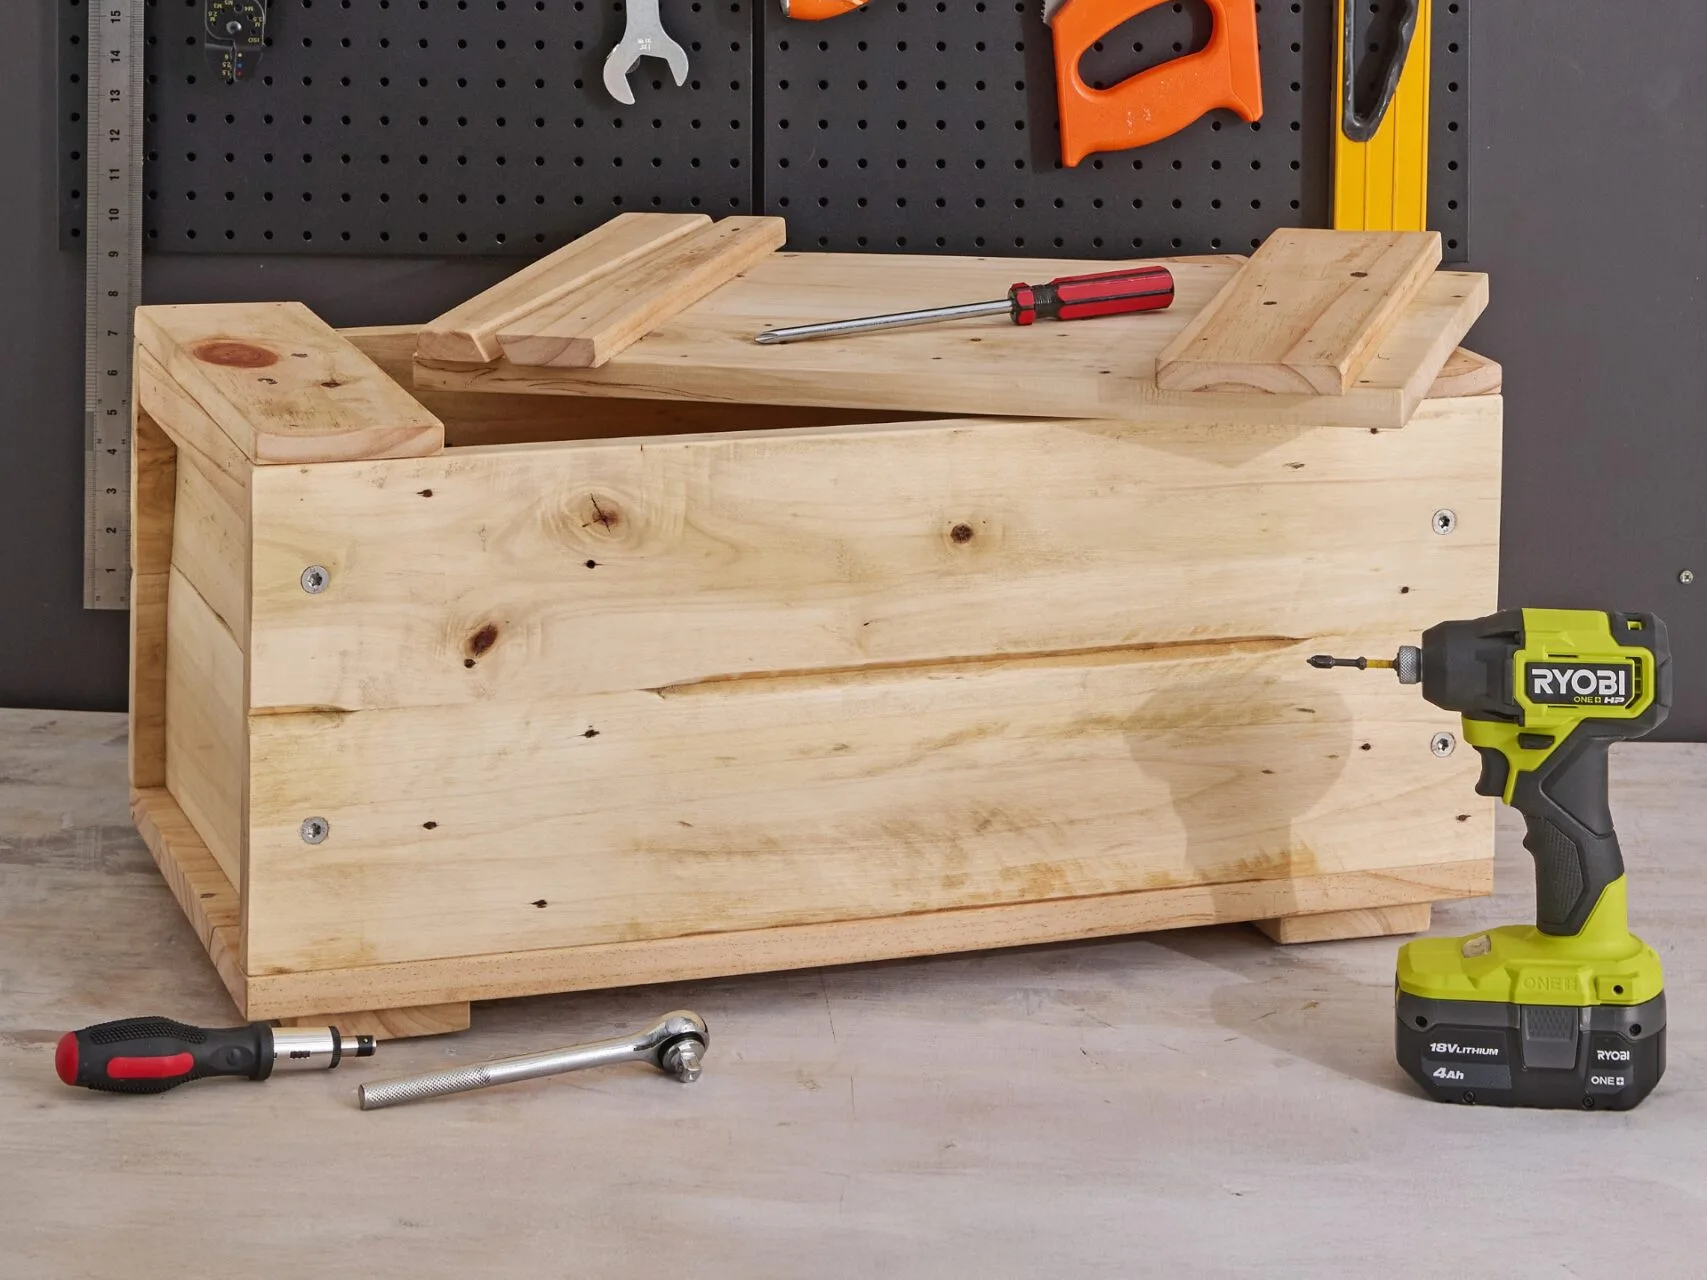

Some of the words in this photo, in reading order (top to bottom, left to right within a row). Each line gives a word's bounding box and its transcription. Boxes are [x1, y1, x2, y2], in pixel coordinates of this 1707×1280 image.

[111, 11, 120, 23] 15
[111, 51, 120, 63] 14
[110, 90, 120, 102] 13
[110, 130, 120, 142] 12
[109, 169, 119, 180] 11
[109, 209, 119, 221] 10
[1532, 669, 1625, 695] RYOBI
[1597, 1050, 1630, 1061] RYOBI
[1433, 1067, 1464, 1080] 4Ah
